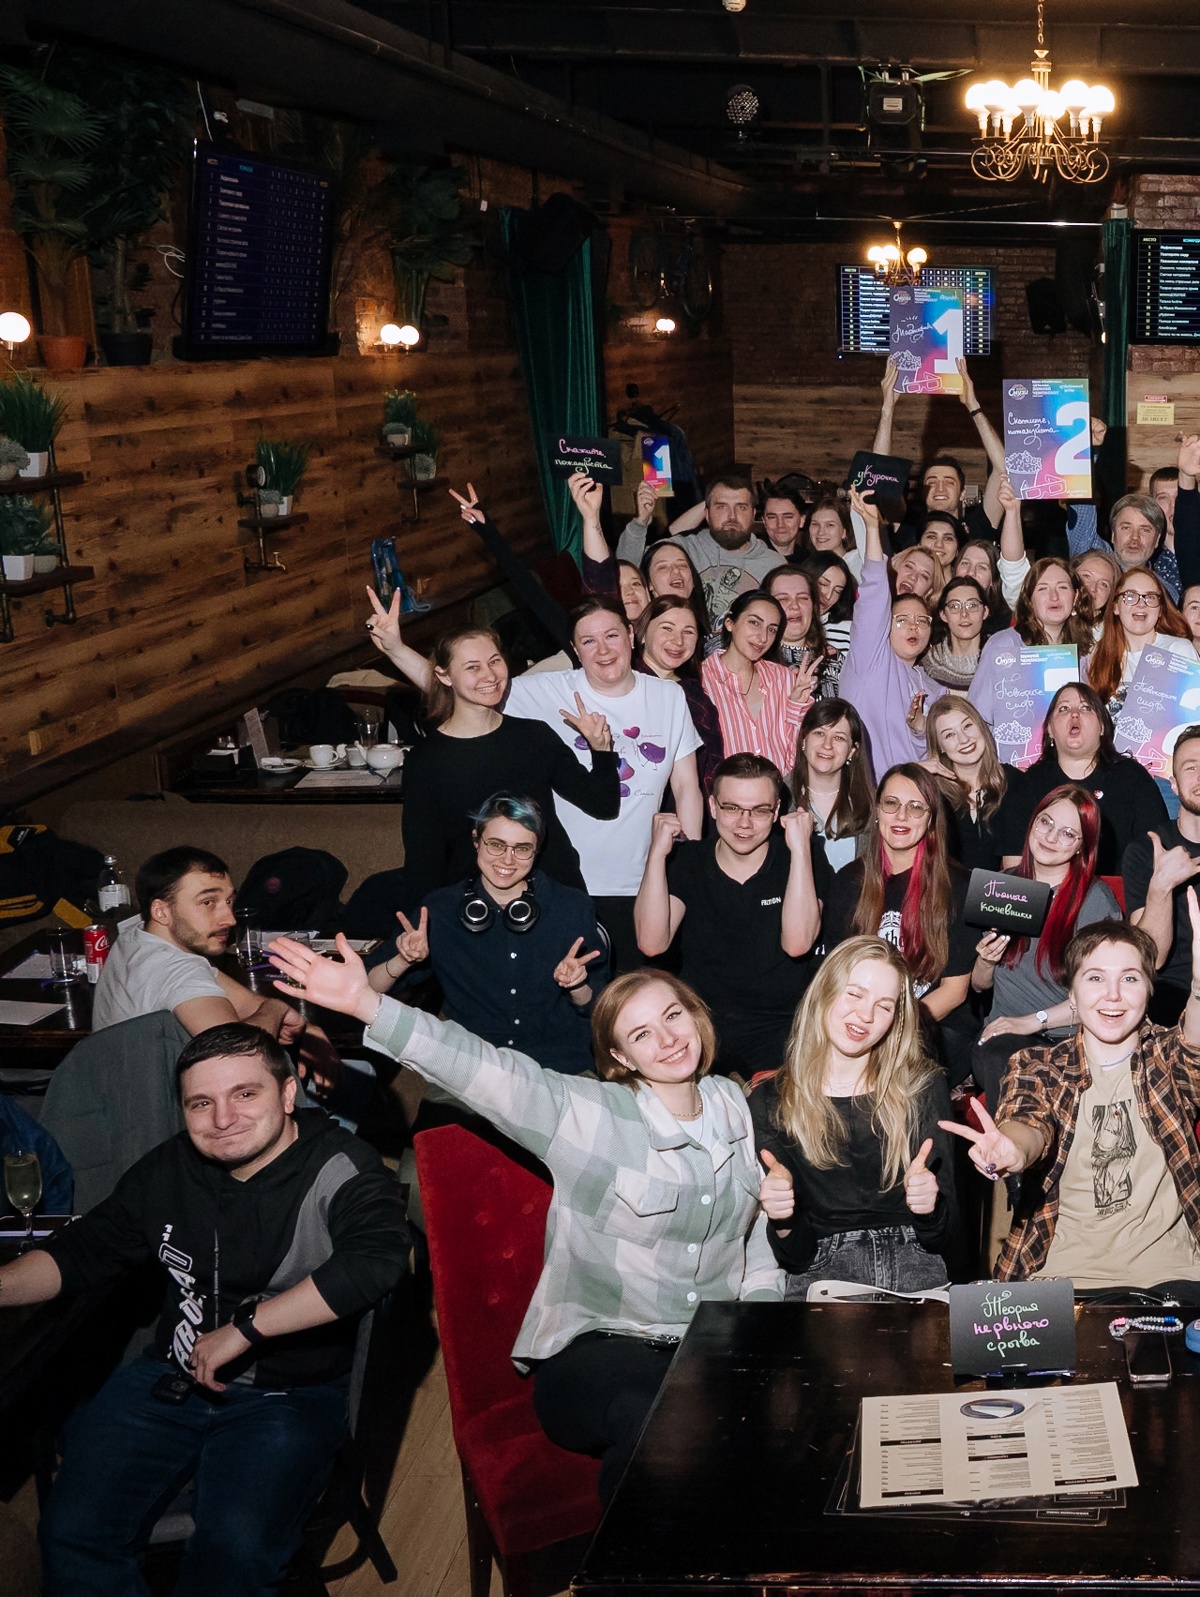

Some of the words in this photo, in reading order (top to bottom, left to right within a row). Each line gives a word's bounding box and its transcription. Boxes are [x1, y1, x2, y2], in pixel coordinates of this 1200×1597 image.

[932, 309, 963, 374] 1
[1054, 401, 1091, 475] 2
[654, 444, 672, 479] 1
[983, 880, 1028, 903] Пьяные
[980, 1290, 1040, 1323] Теория
[973, 1316, 1050, 1340] нервного
[986, 1330, 1041, 1358] срыва
